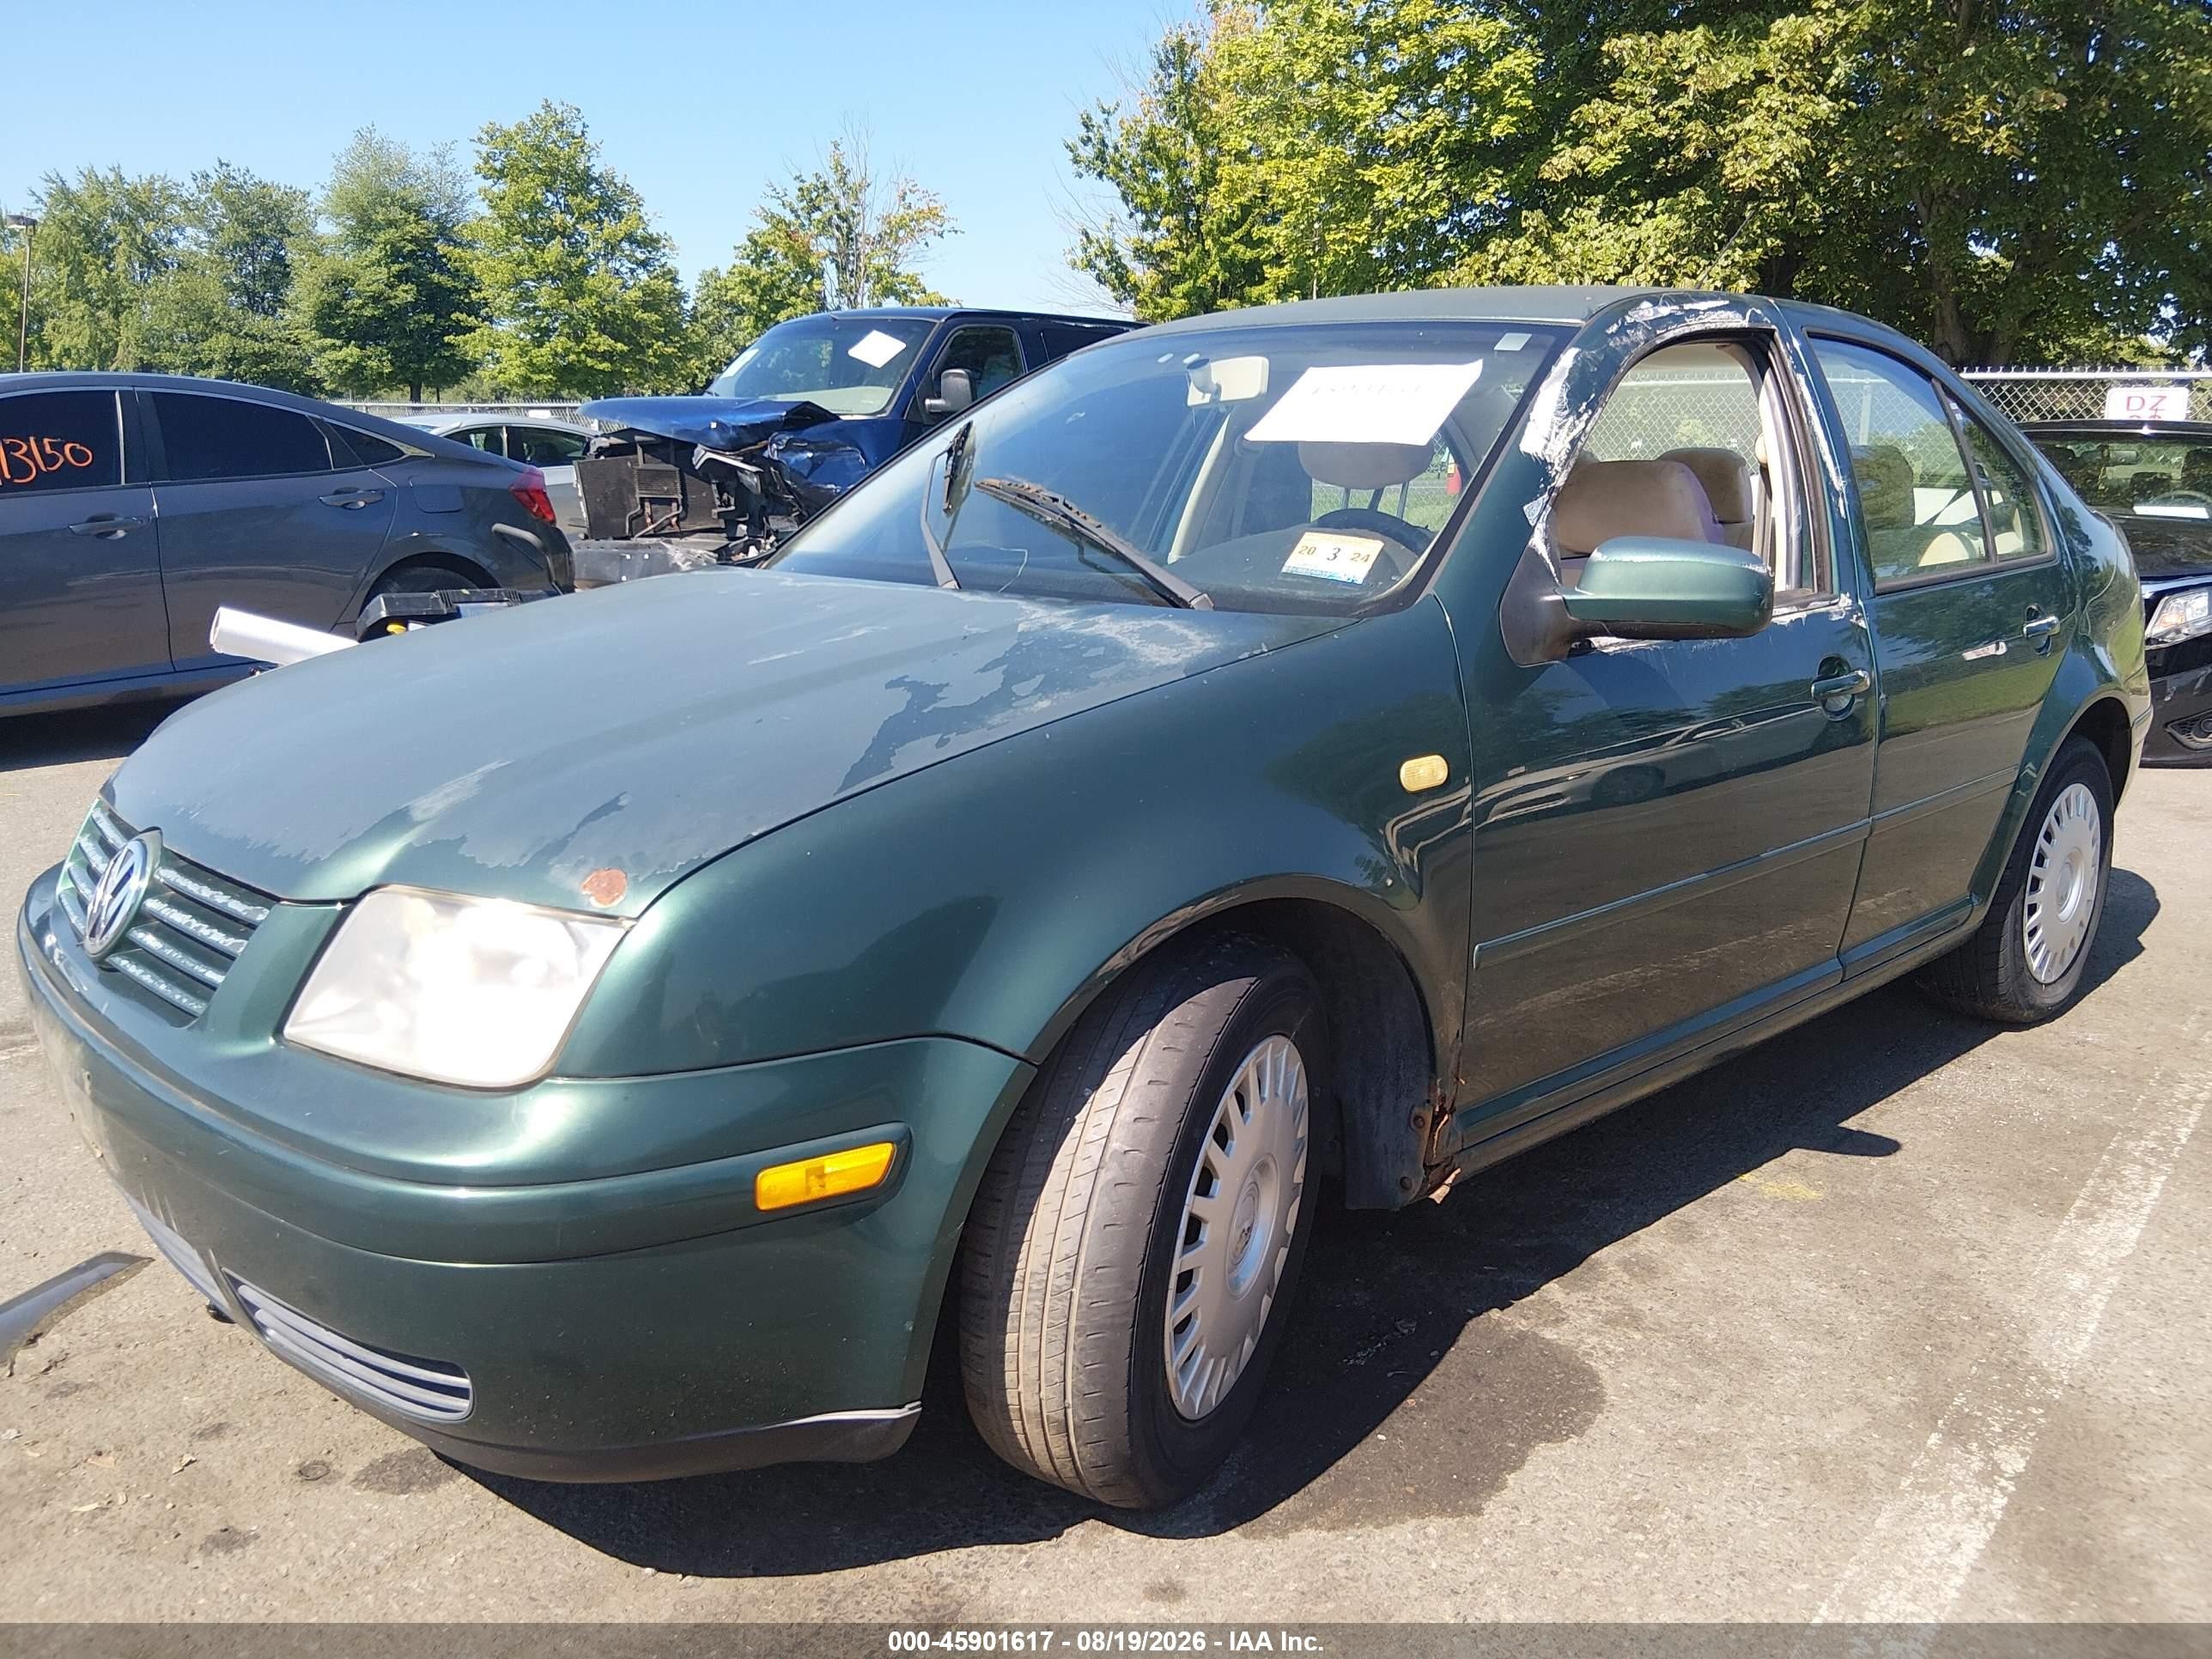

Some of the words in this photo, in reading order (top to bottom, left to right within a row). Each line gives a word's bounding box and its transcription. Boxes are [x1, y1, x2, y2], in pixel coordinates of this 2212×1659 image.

[2125, 396, 2167, 411] DZ
[1297, 544, 1317, 556] 20
[1326, 546, 1341, 562] 3
[1350, 552, 1370, 564] 24
